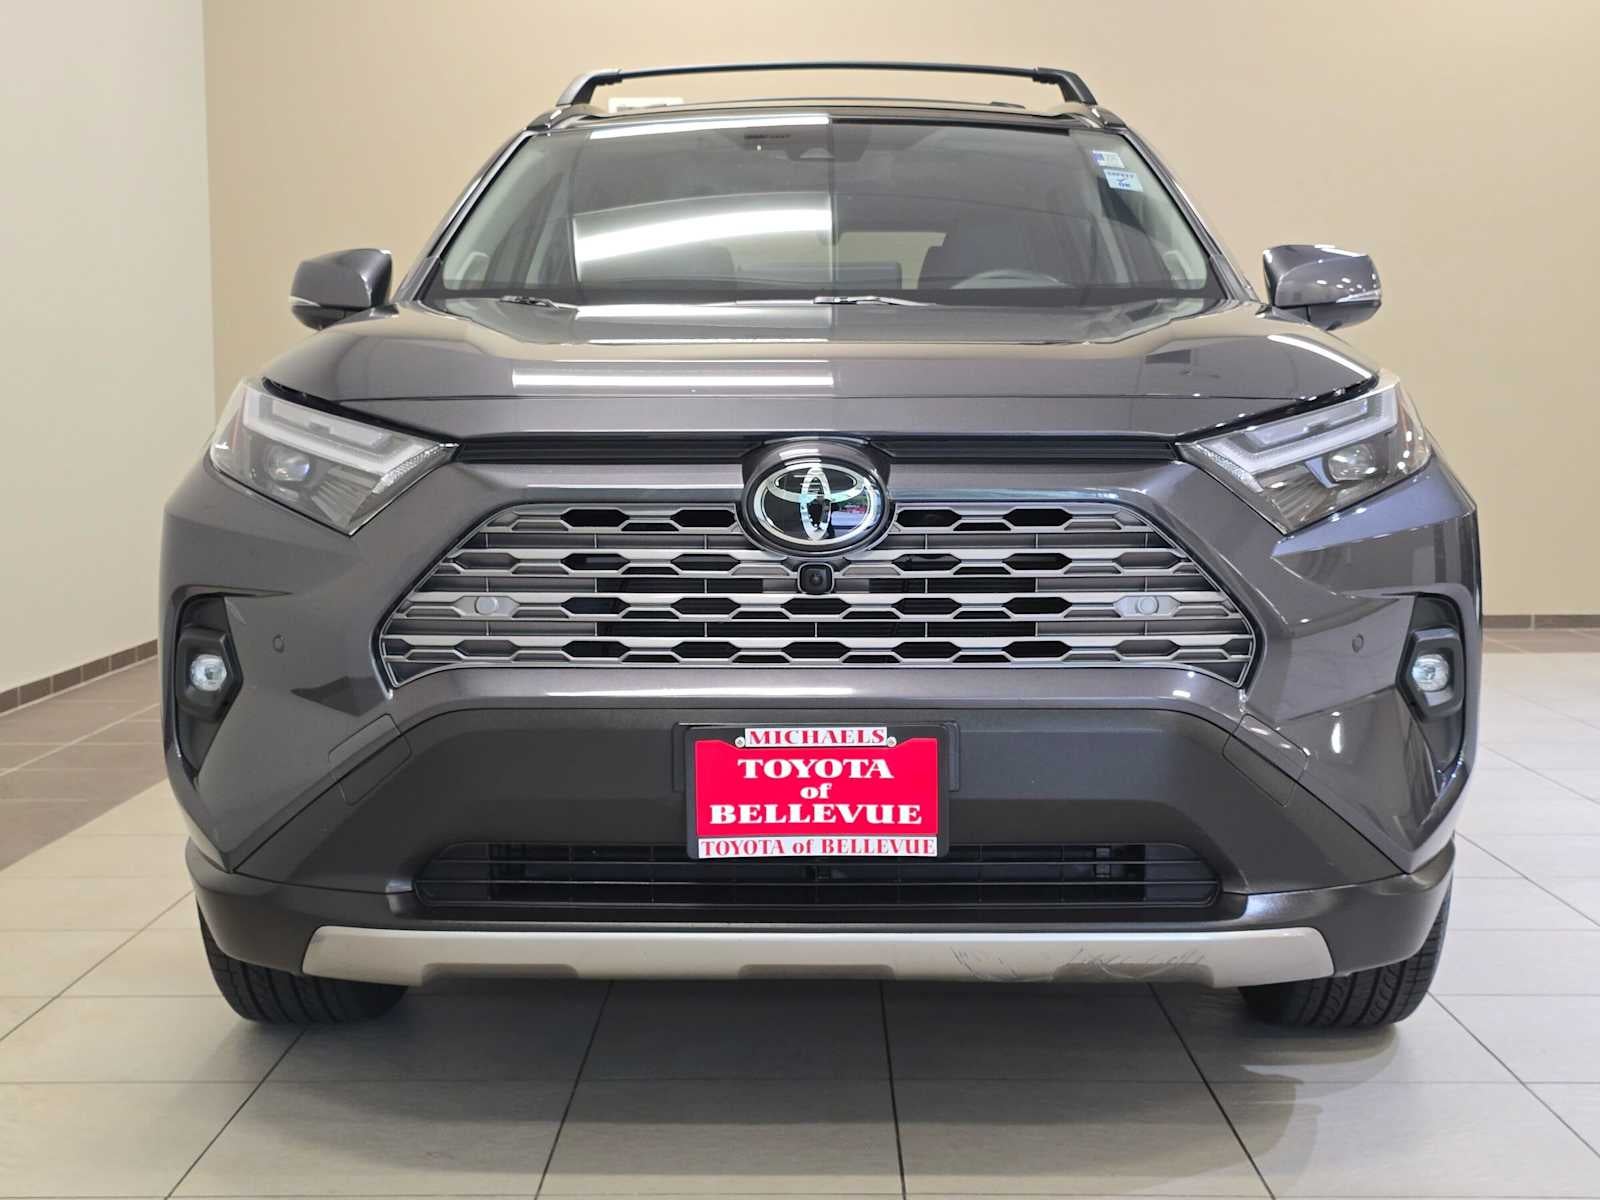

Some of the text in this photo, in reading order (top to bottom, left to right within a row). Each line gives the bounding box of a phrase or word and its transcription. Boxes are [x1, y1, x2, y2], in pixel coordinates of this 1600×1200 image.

[748, 729, 886, 745] MICHAELS
[737, 758, 894, 779] TOYOTA
[800, 782, 832, 800] of
[709, 803, 922, 825] BELLEVUE
[701, 838, 936, 856] TOYOTA of BELLEVUE
